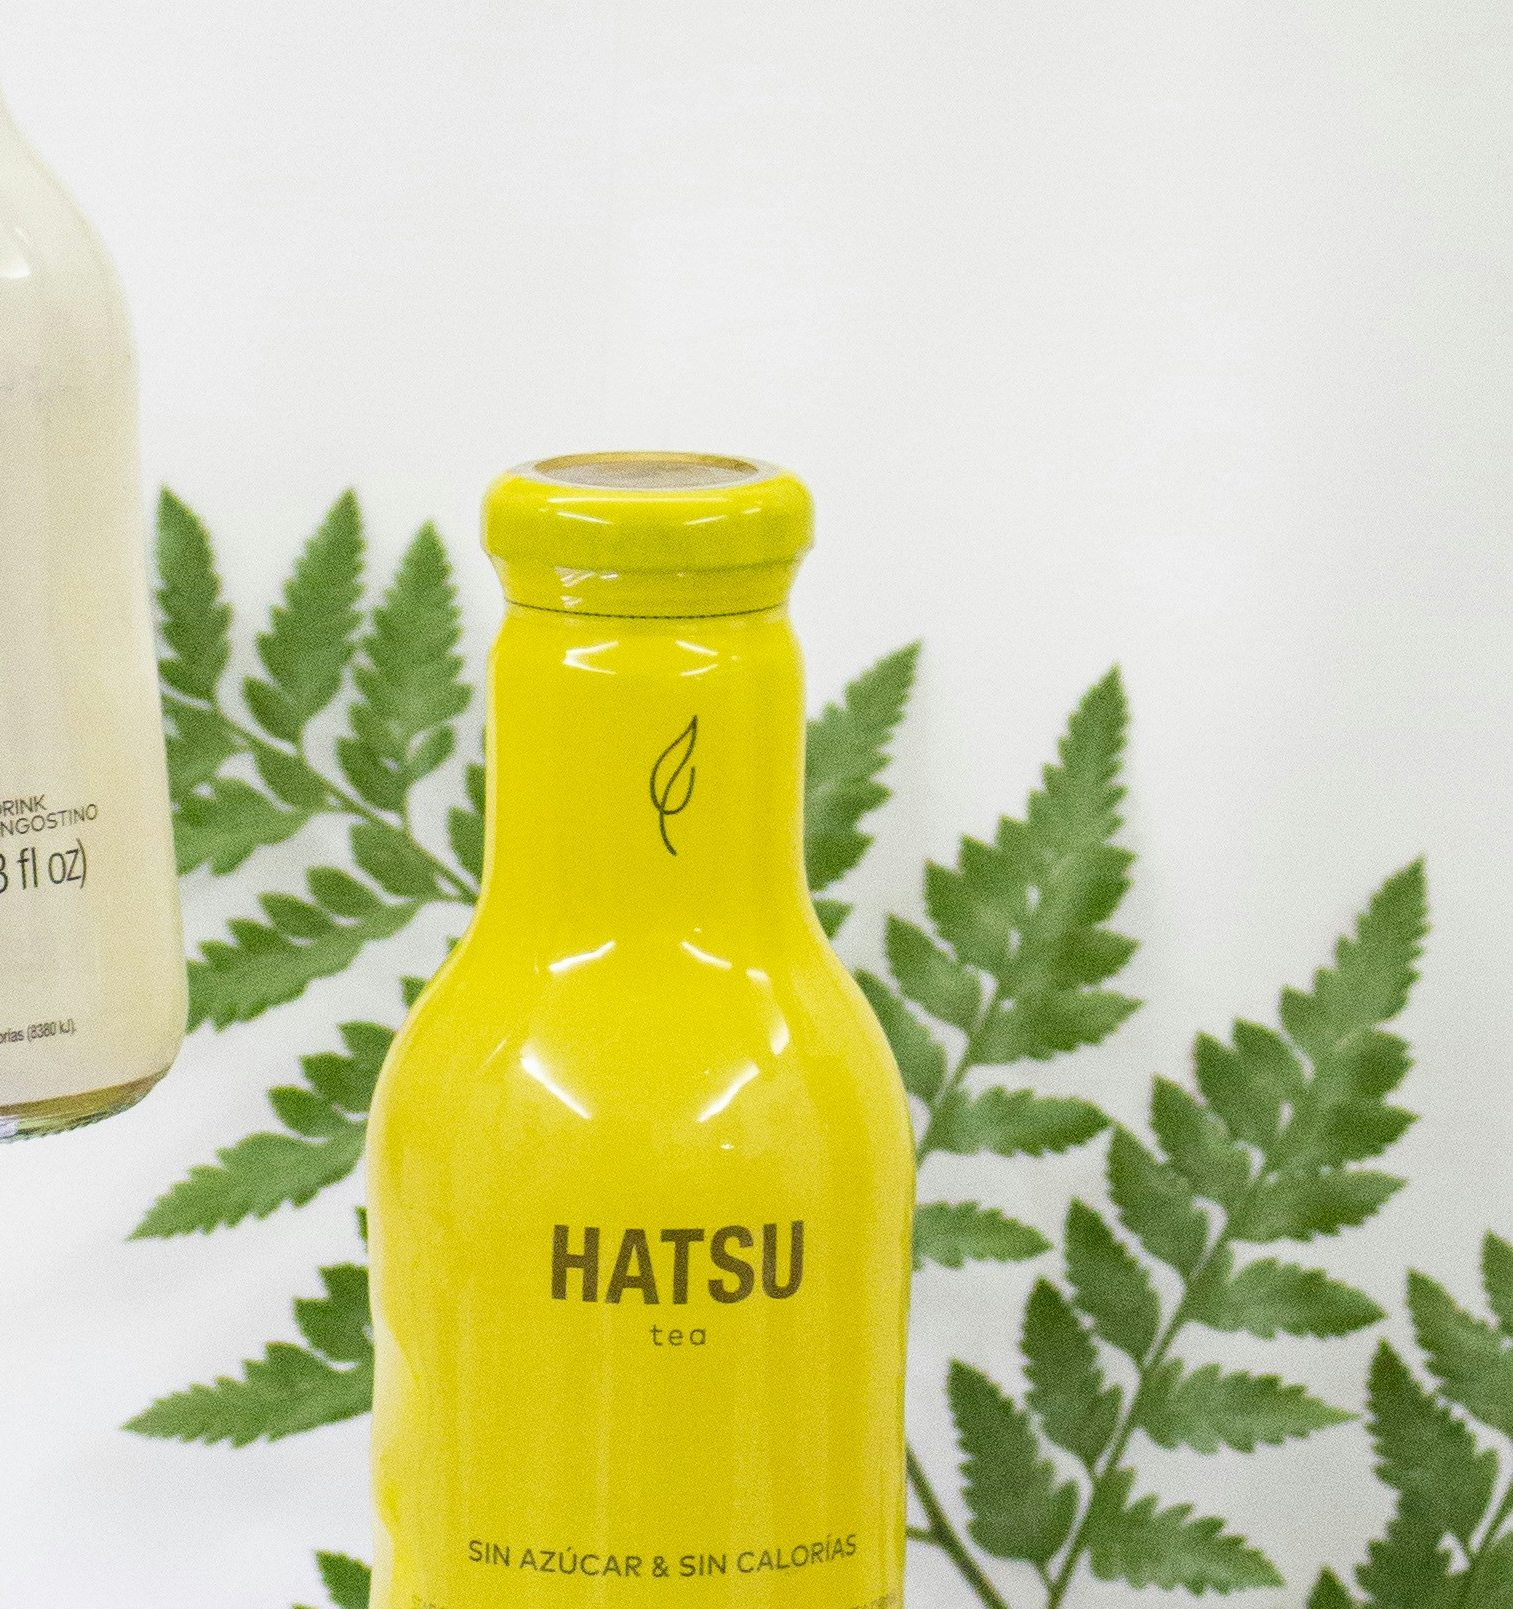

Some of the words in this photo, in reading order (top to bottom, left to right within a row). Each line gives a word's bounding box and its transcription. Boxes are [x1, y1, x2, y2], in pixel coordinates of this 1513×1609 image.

[17, 847, 38, 890] fl
[48, 838, 87, 890] oz)
[551, 1219, 805, 1306] HATSU
[650, 1323, 707, 1347] tea
[468, 1540, 510, 1567] SIN
[519, 1546, 642, 1577] AZÚCAR
[652, 1555, 670, 1578] &
[679, 1554, 727, 1578] SIN
[736, 1533, 857, 1574] CALORÍAS
